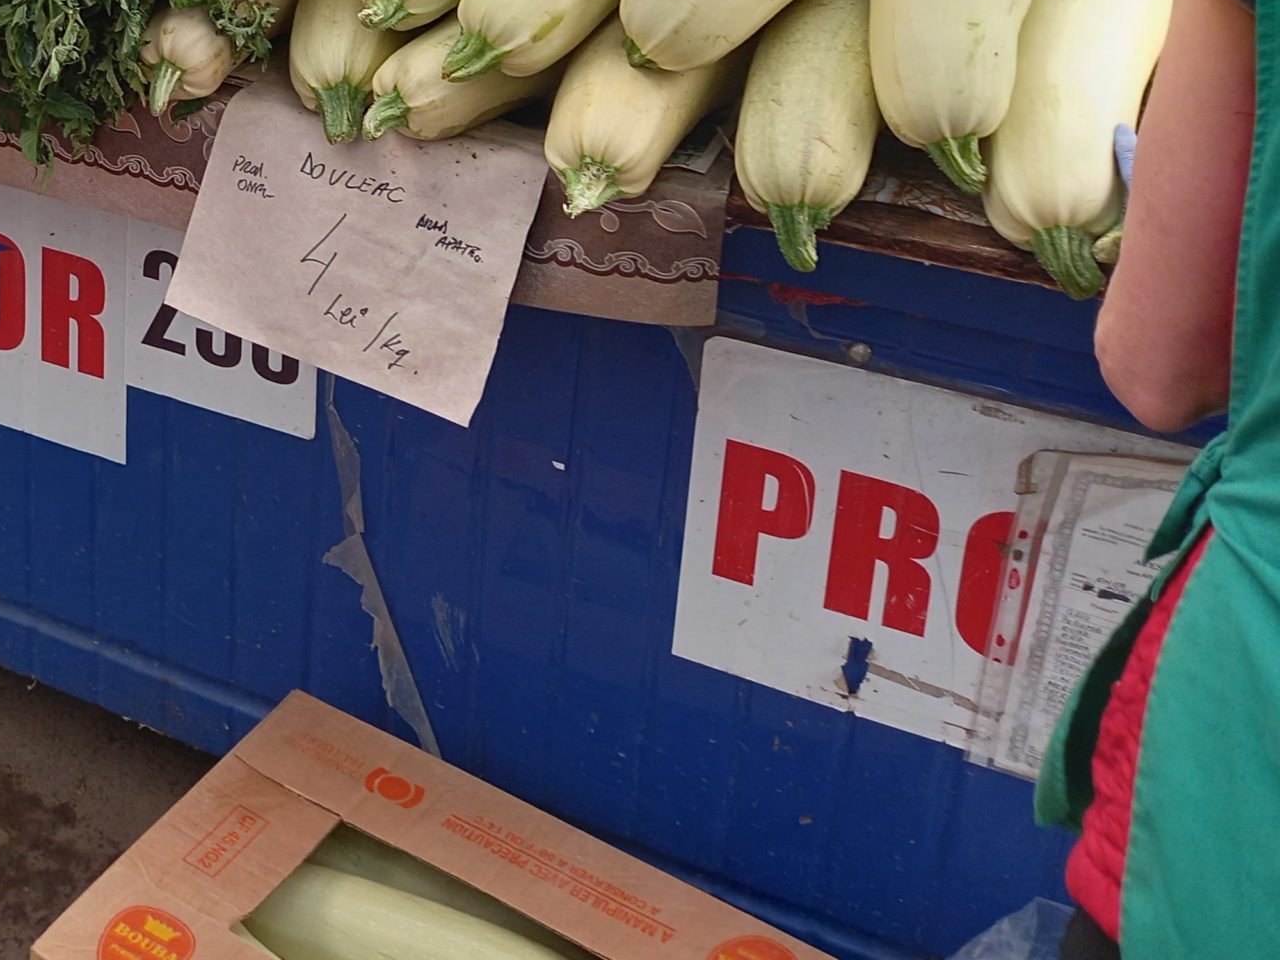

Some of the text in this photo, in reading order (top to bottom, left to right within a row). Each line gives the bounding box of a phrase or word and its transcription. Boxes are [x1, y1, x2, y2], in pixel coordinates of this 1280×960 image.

[300, 213, 347, 296] 4
[238, 815, 257, 833] CF
[441, 815, 529, 871] PRECAUTION
[569, 885, 659, 938] MANIPULER
